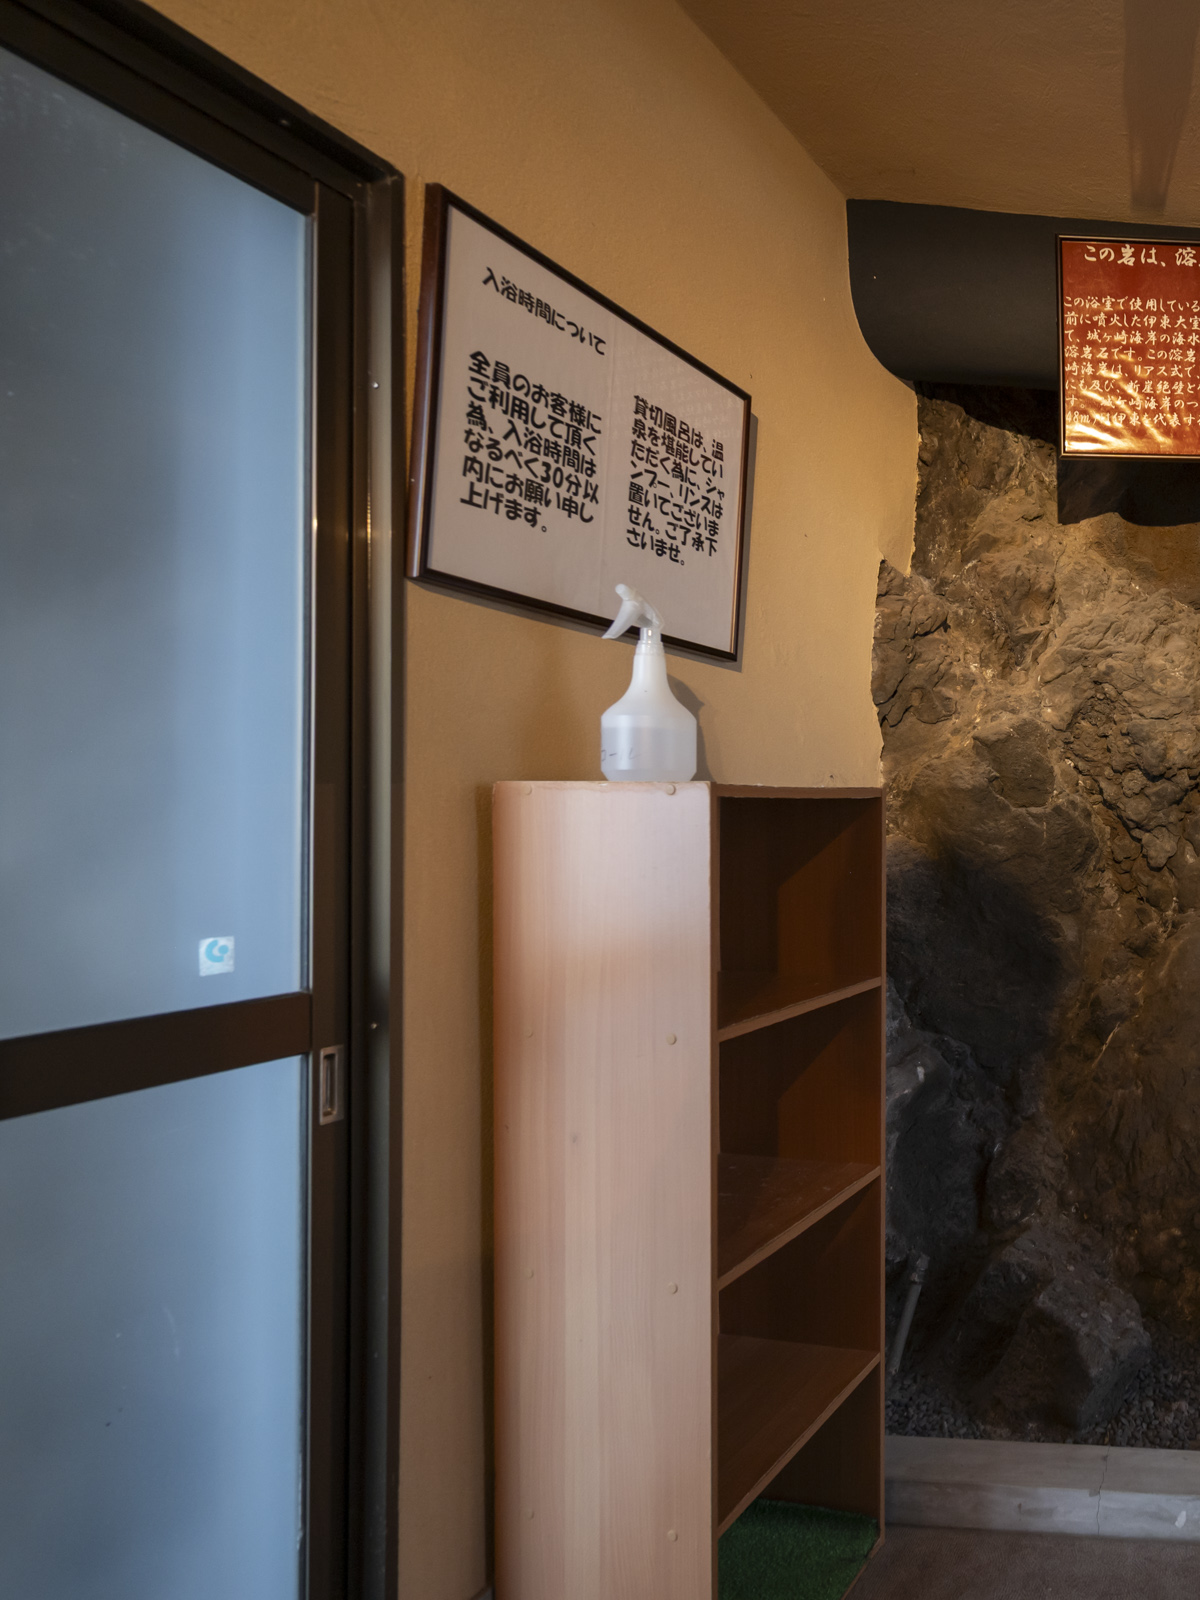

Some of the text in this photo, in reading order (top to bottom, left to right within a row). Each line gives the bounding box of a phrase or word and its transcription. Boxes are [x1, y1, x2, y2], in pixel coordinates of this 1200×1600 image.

[482, 267, 606, 355] 入浴時間について
[467, 376, 597, 456] ご利用して頂く
[468, 350, 602, 434] 全員のお客様に
[466, 400, 597, 478] 為、入浴時間は
[632, 418, 723, 478] 泉を堪能してい
[633, 395, 724, 462] 貸切風呂は、温
[462, 455, 594, 523] 内にお願い申し
[464, 428, 599, 504] なるべく30分以
[630, 460, 723, 519] ンプー、リンスは
[631, 439, 725, 501] ただく為に、シャ
[460, 481, 547, 533] 上げます。
[627, 505, 718, 557] せん。ご了承下
[628, 481, 719, 537] 置いてございま
[626, 528, 685, 566] さいませ。
